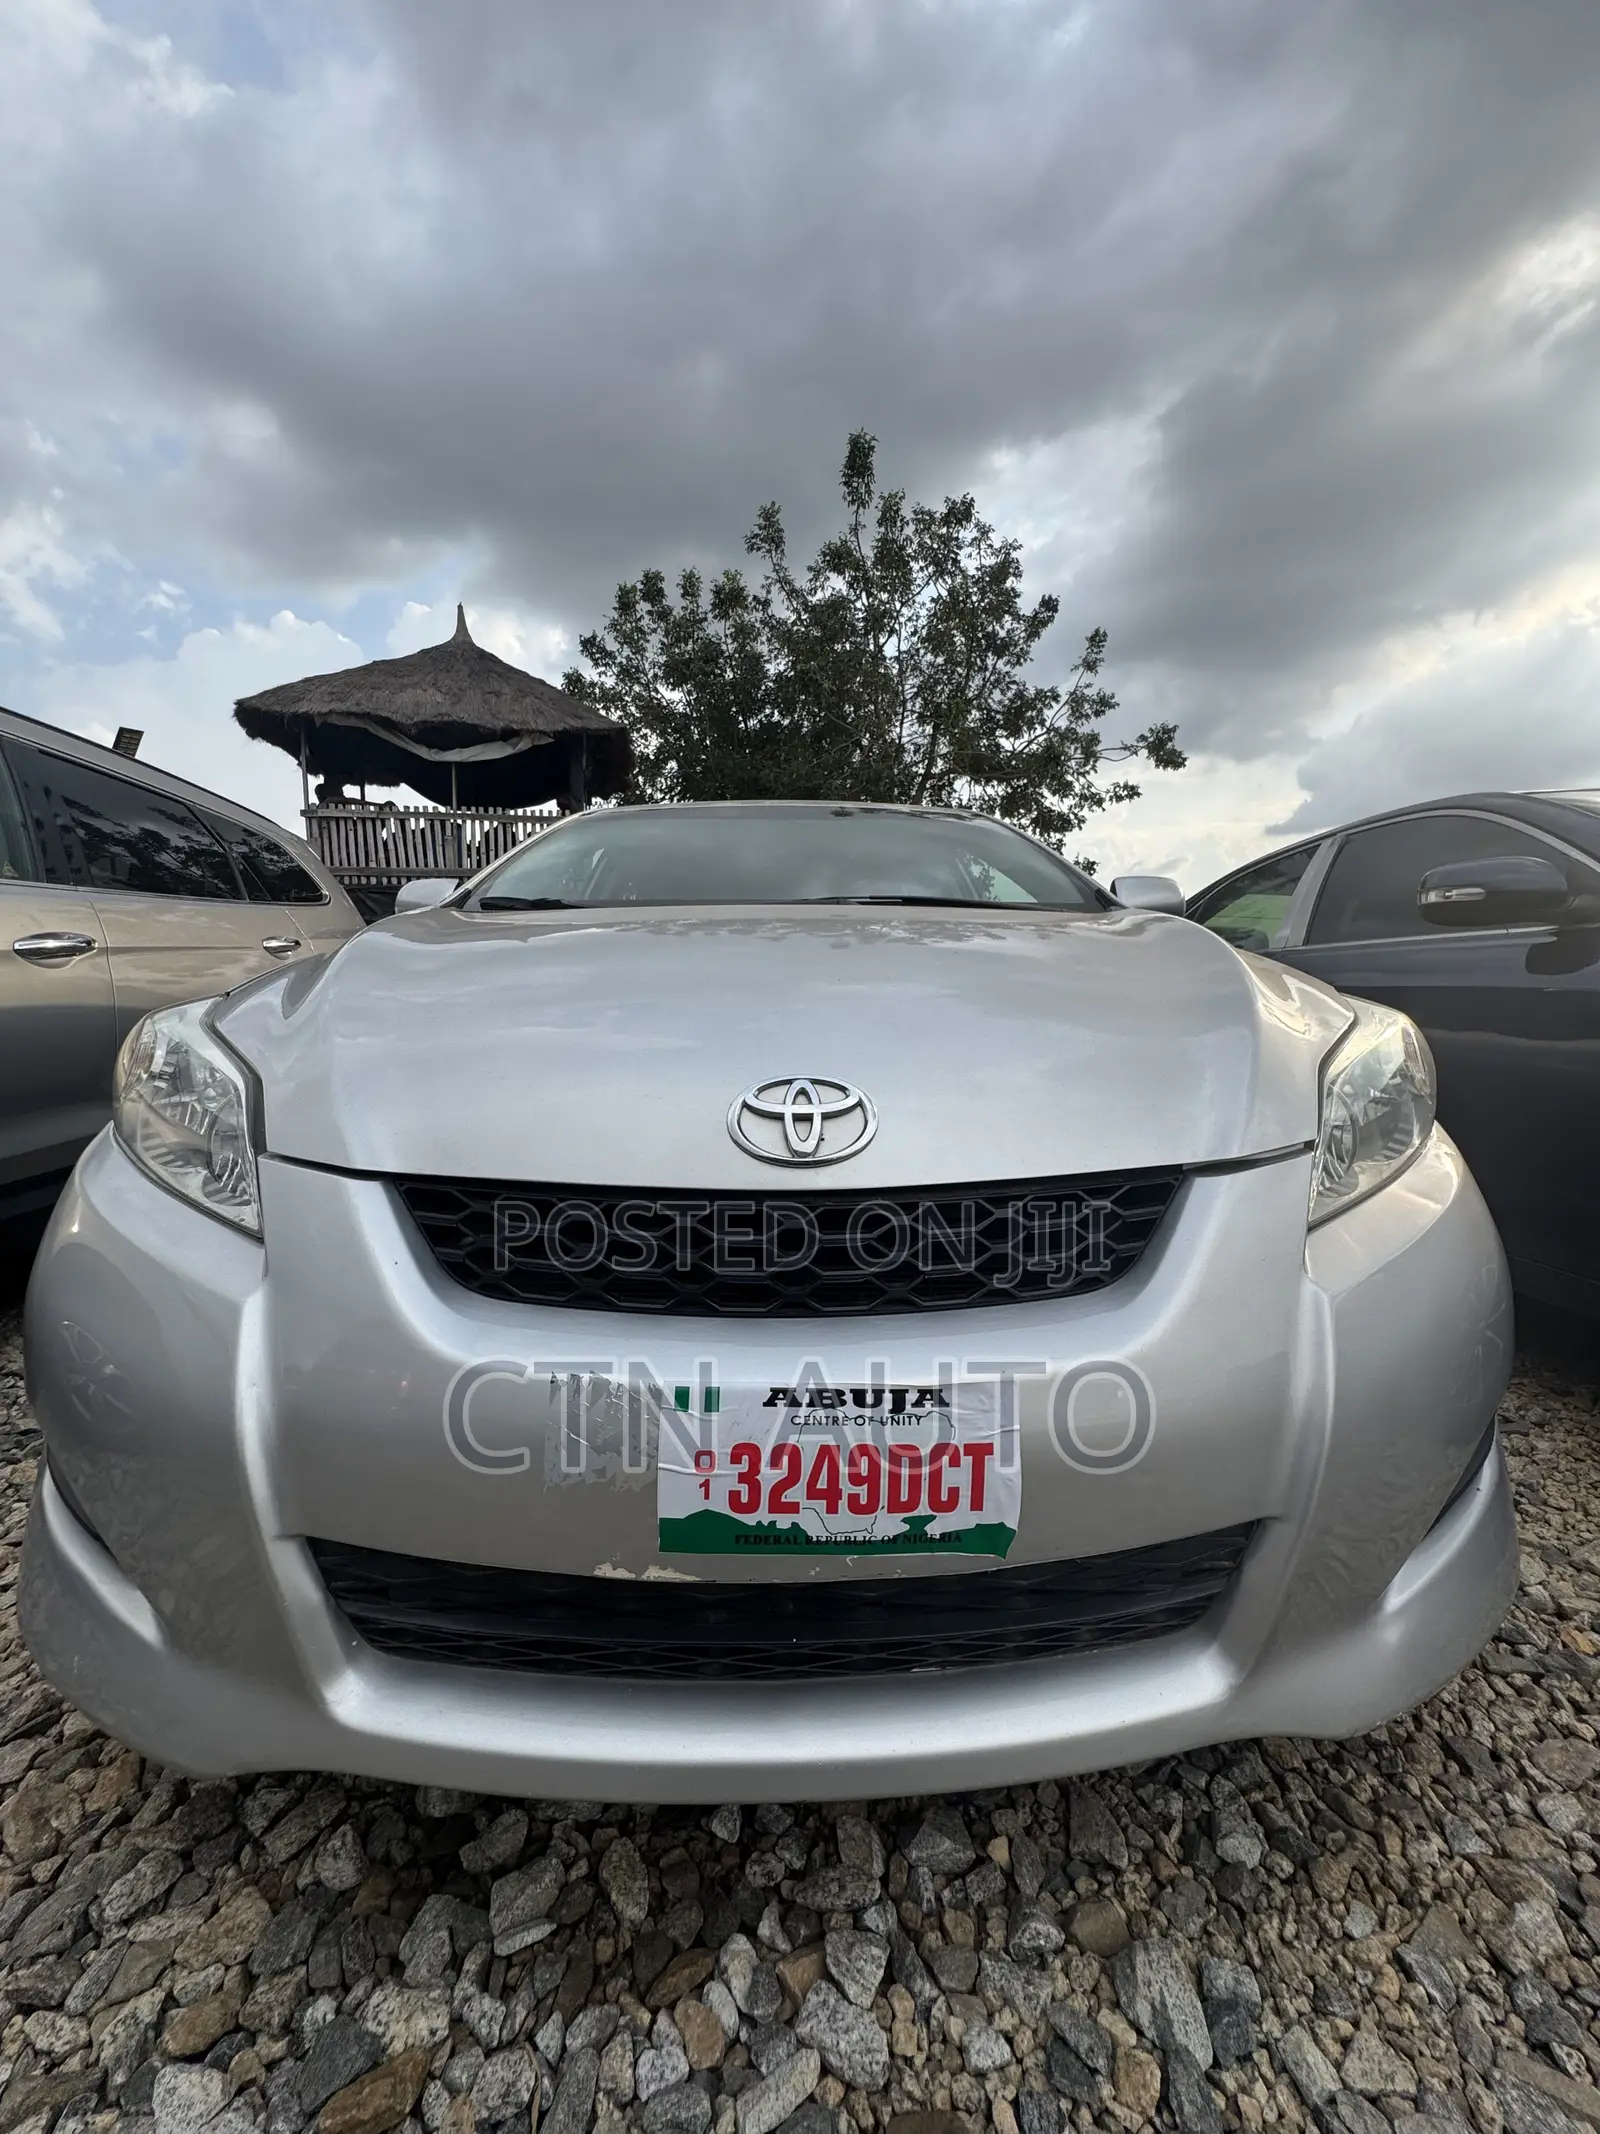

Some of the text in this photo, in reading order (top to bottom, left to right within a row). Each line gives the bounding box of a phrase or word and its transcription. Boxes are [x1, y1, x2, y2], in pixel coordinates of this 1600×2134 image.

[762, 1387, 950, 1415] ABUJA
[790, 1414, 923, 1427] CENTRE OF UNITY
[728, 1442, 995, 1516] 3249DCT
[734, 1530, 962, 1546] FEDERAL REPUBLIC OF NIGERIA
